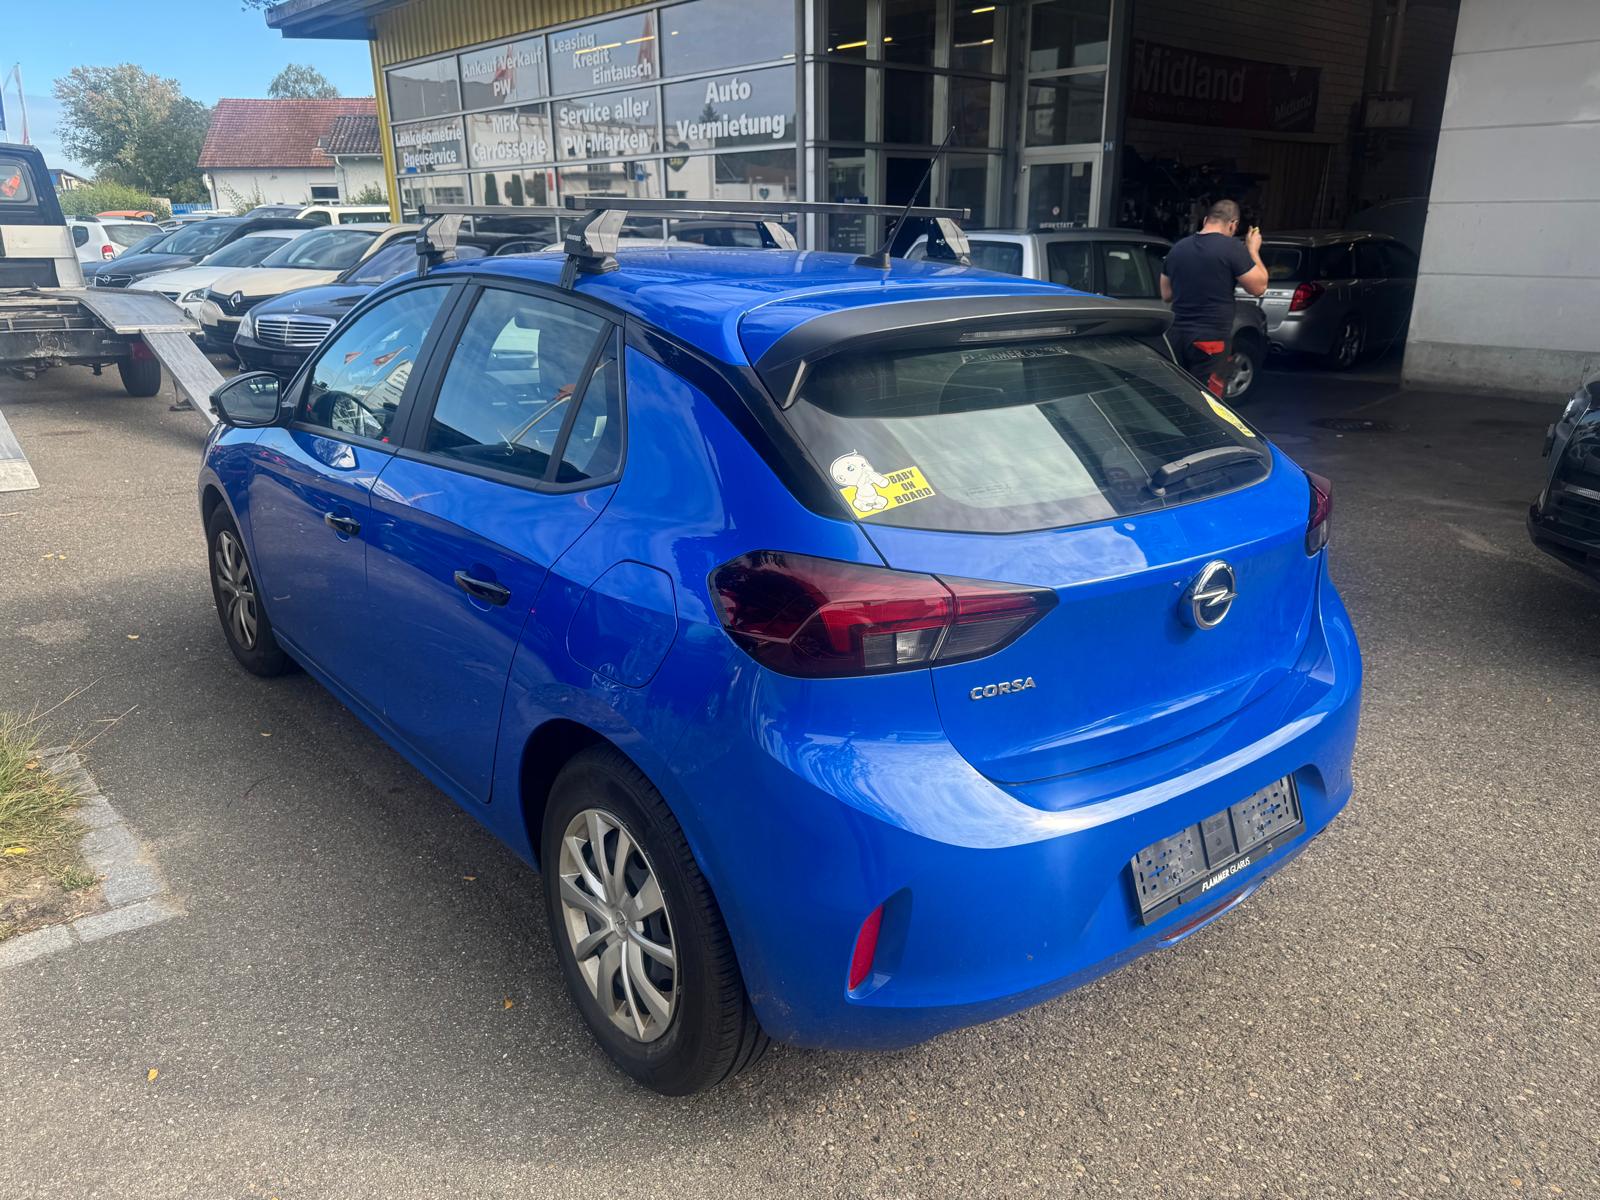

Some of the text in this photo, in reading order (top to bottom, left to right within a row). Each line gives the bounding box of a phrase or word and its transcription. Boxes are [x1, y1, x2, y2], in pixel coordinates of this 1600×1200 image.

[552, 32, 595, 54] Leasing
[573, 49, 610, 69] Kredit
[592, 58, 652, 85] Eintausch
[1133, 48, 1247, 104] Midland
[493, 79, 511, 96] PW
[705, 78, 751, 104] Auto
[560, 96, 650, 125] Service aller
[492, 113, 520, 134] MFK
[676, 113, 786, 141] Vermietung
[395, 124, 462, 148] Lenkgeometrie
[564, 128, 649, 153] PW-Marken
[403, 147, 457, 167] Pneuservice
[472, 135, 547, 162] Carrosserie
[889, 470, 914, 484] BABY
[901, 480, 916, 491] ON
[894, 487, 933, 504] BOARD
[970, 676, 1037, 700] CORSA
[1201, 856, 1251, 893] FLAMMER GLARUS
